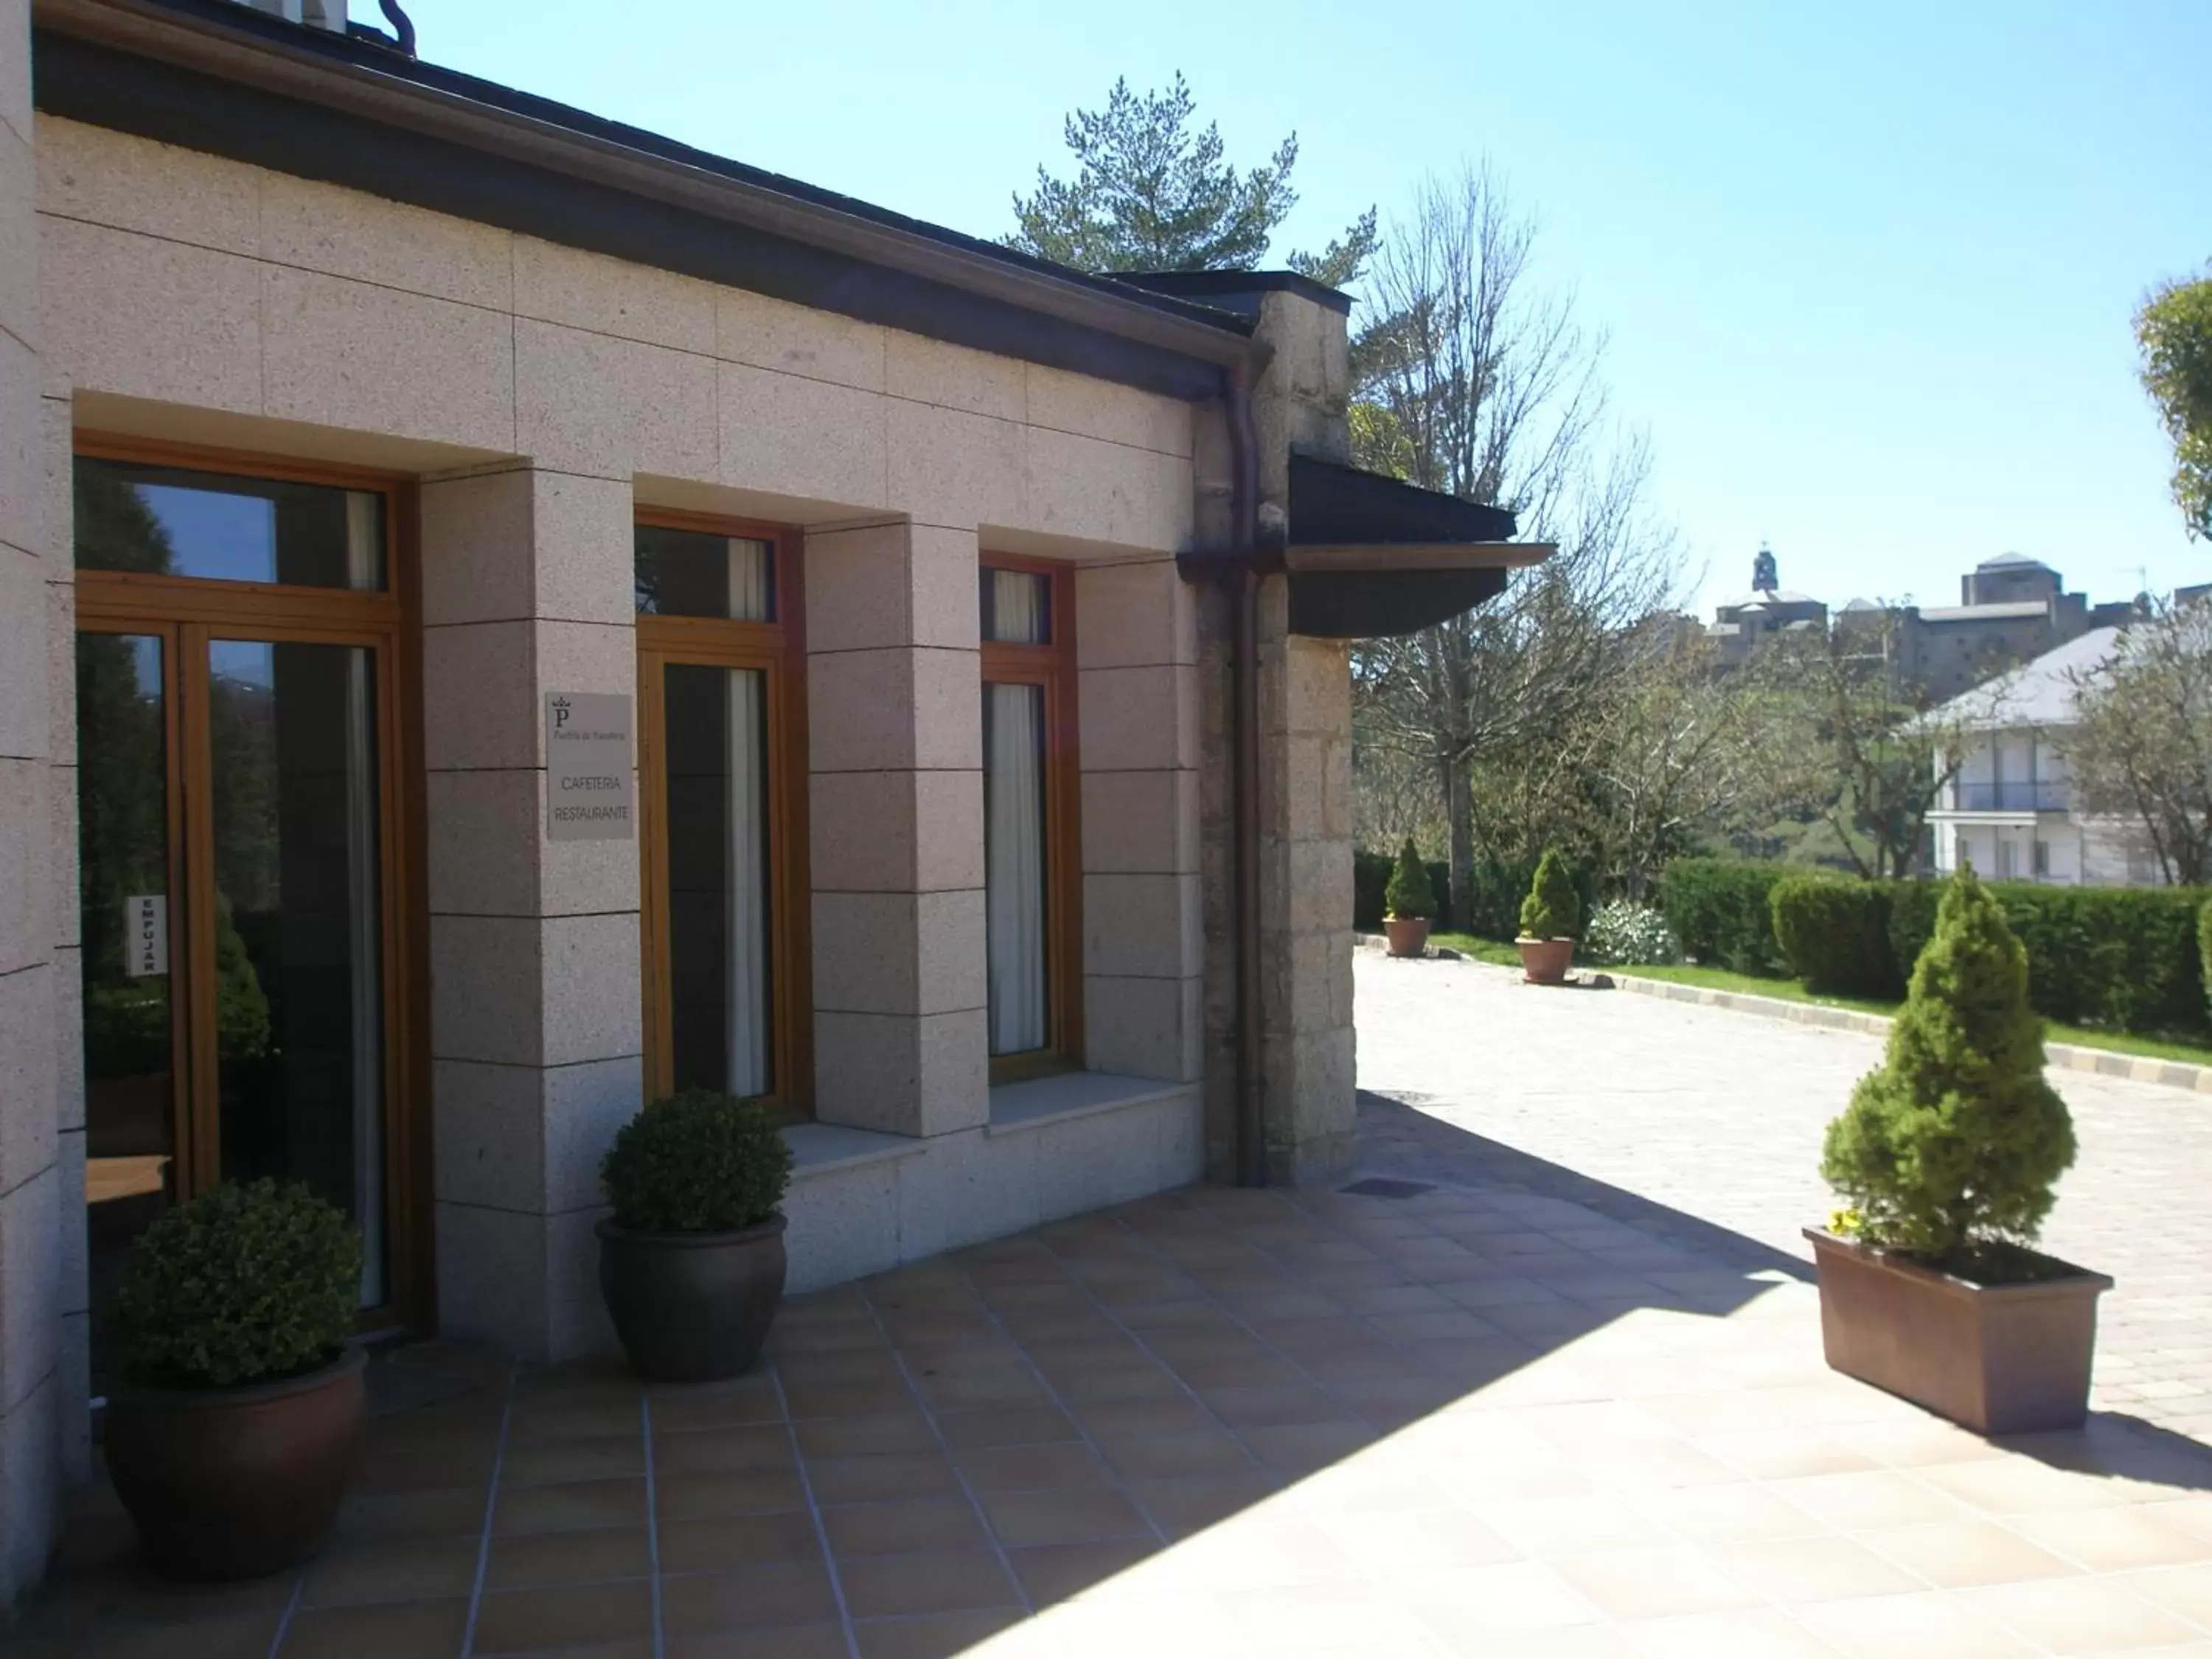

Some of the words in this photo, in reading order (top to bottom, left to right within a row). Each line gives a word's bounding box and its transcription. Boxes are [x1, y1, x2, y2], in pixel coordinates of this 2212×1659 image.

[555, 709, 569, 727] P
[554, 806, 627, 821] RESTAURANTE
[142, 899, 155, 971] EMPUJAR
